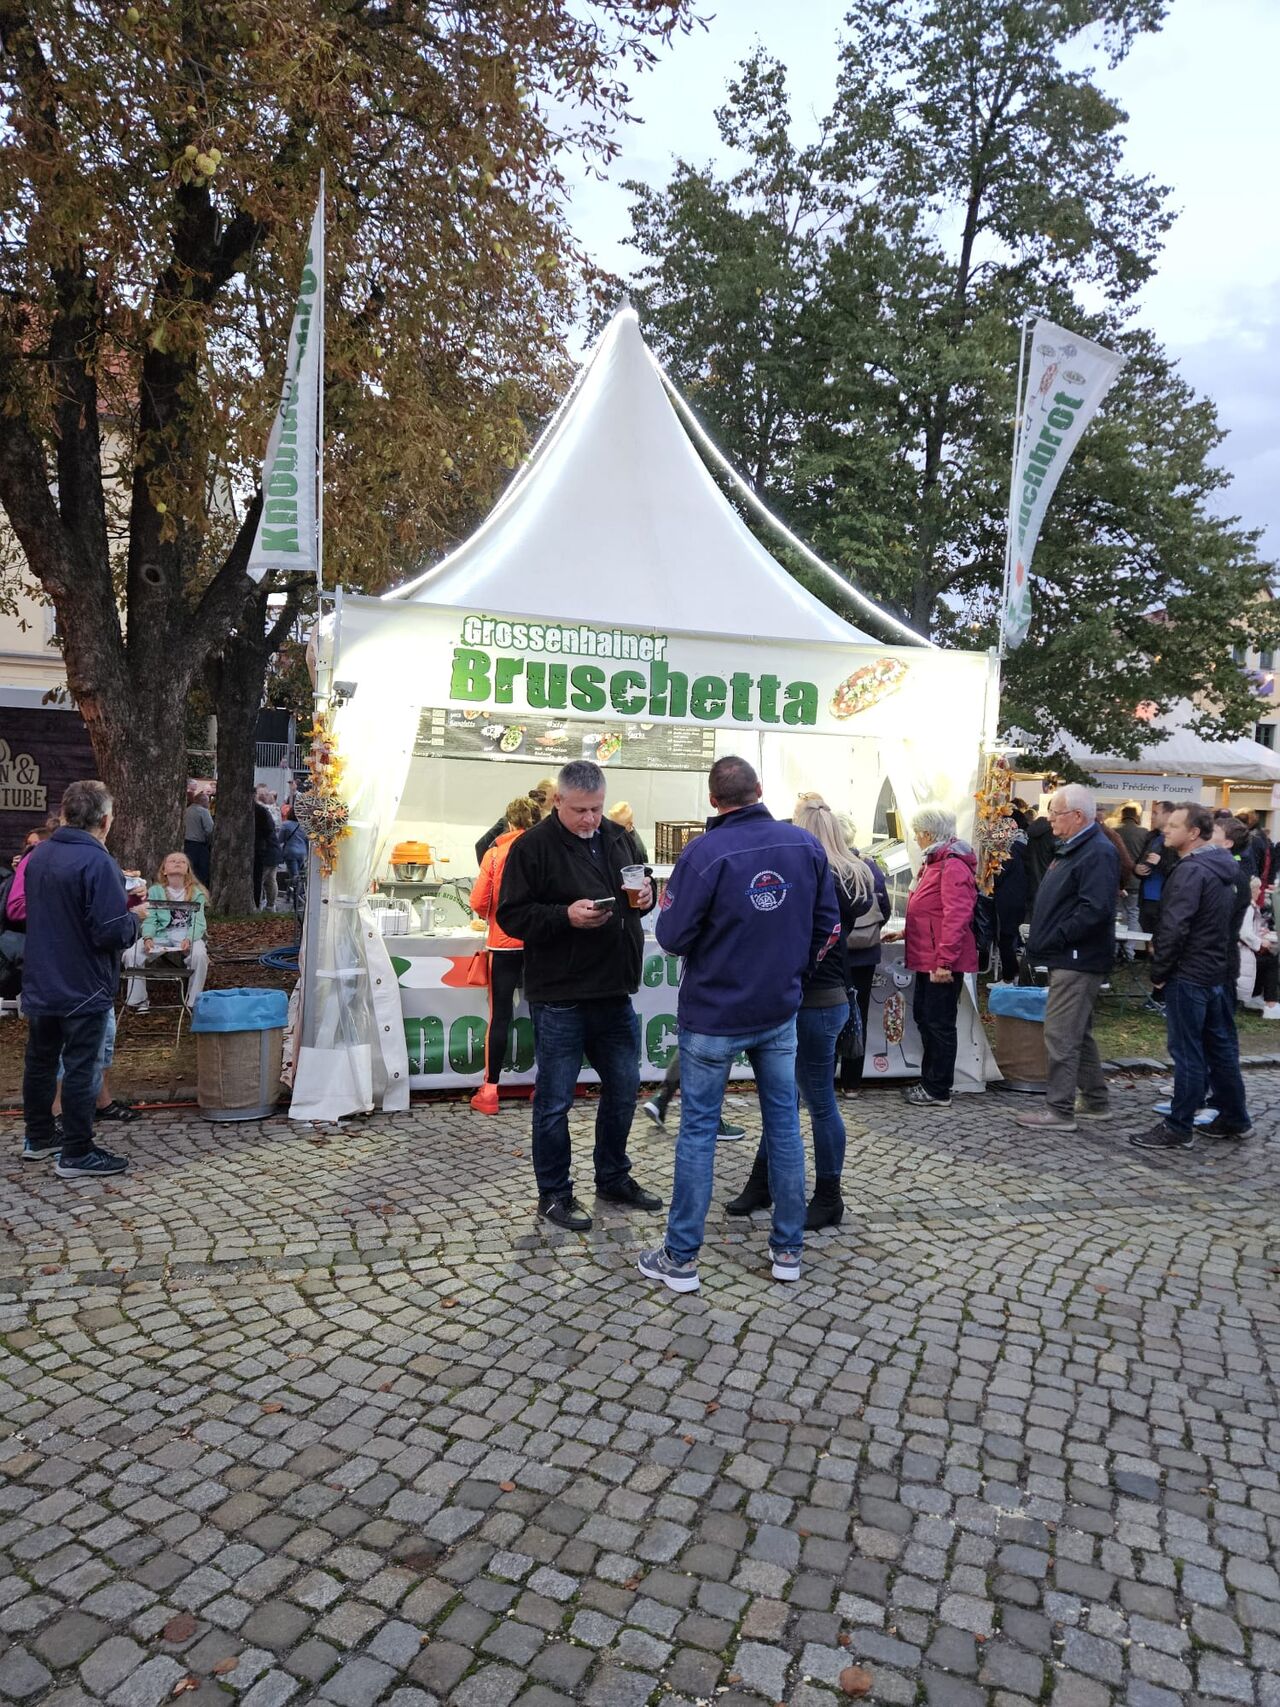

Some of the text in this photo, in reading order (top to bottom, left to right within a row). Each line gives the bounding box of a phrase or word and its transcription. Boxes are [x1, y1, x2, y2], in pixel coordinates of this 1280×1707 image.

[463, 614, 668, 662] Grossenhainer
[449, 647, 819, 727] Bruschetta
[17, 757, 35, 785] &
[1121, 782, 1160, 792] Frédéric
[1162, 784, 1194, 794] Fourré
